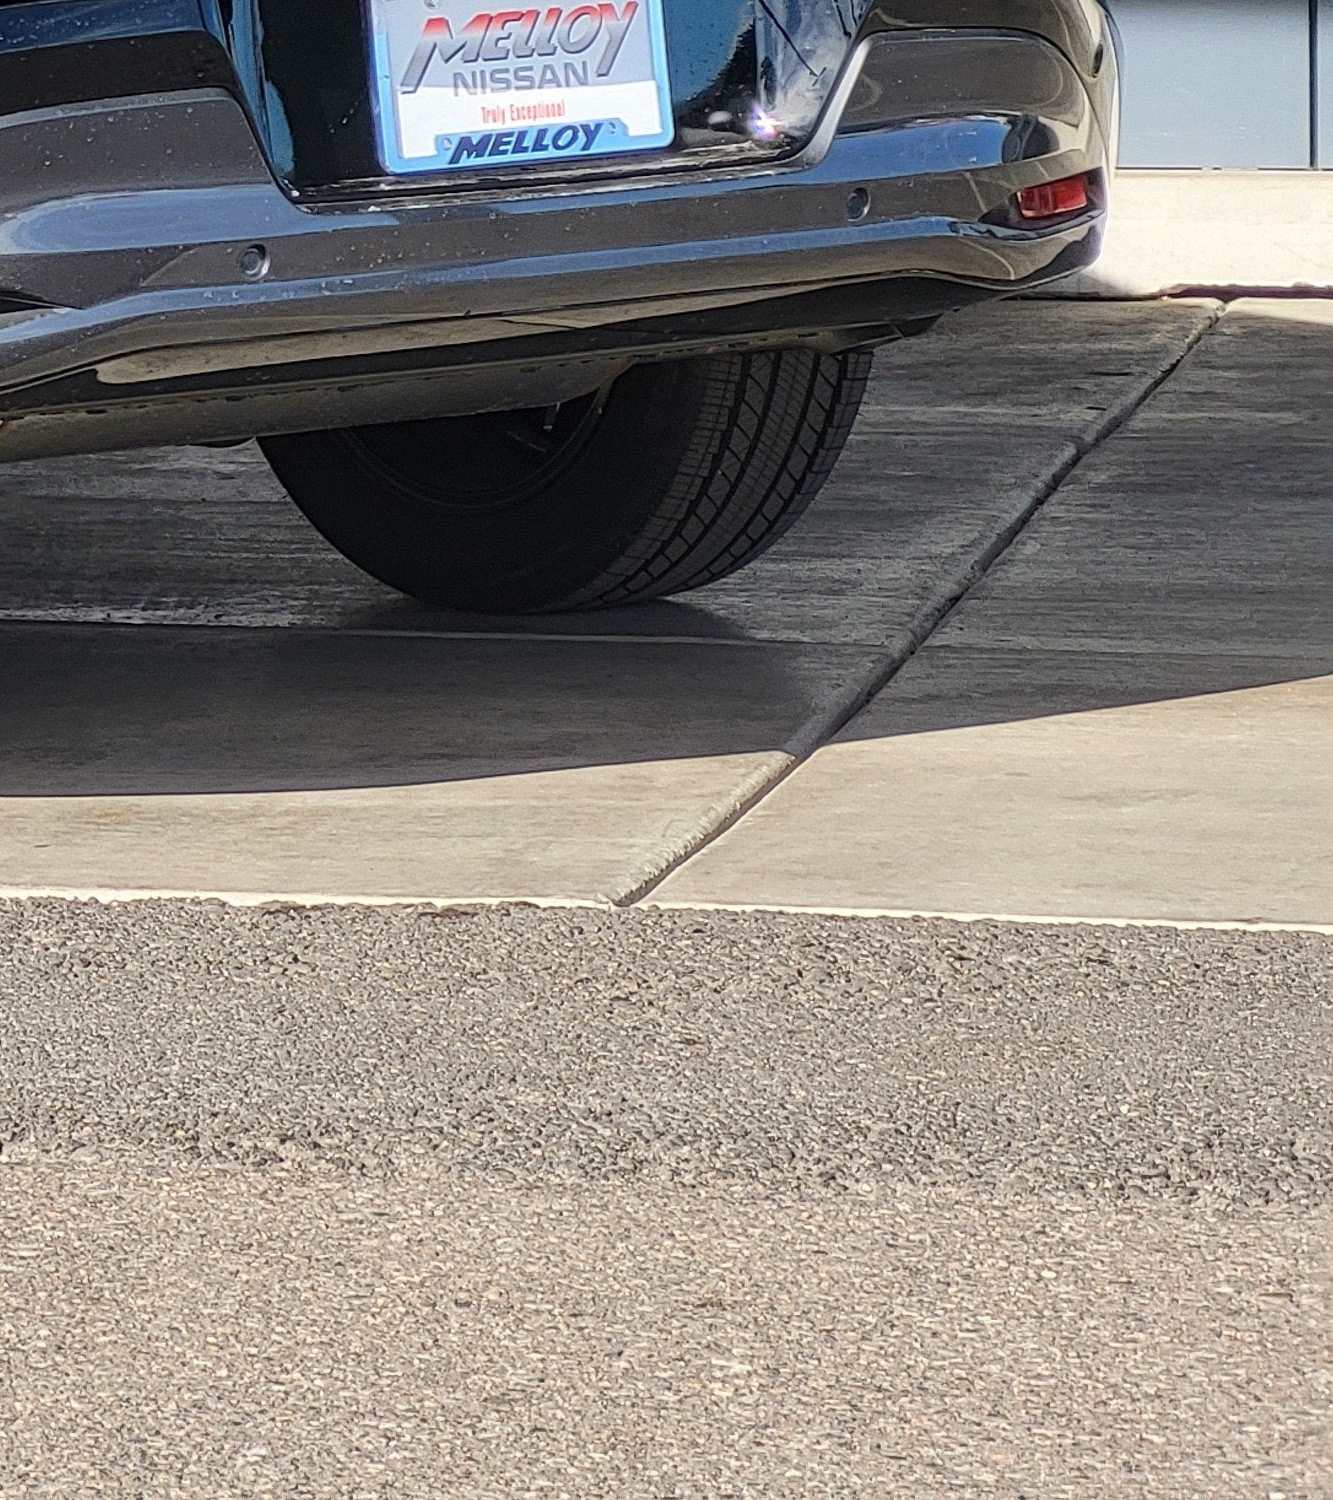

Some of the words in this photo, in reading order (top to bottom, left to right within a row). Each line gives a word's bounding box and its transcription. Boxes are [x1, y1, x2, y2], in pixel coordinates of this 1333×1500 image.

[400, 0, 639, 95] MELLOY
[452, 60, 590, 98] NISSAN
[480, 103, 507, 126] Truly
[509, 98, 567, 123] Exceptional
[447, 121, 604, 165] MELLOY
